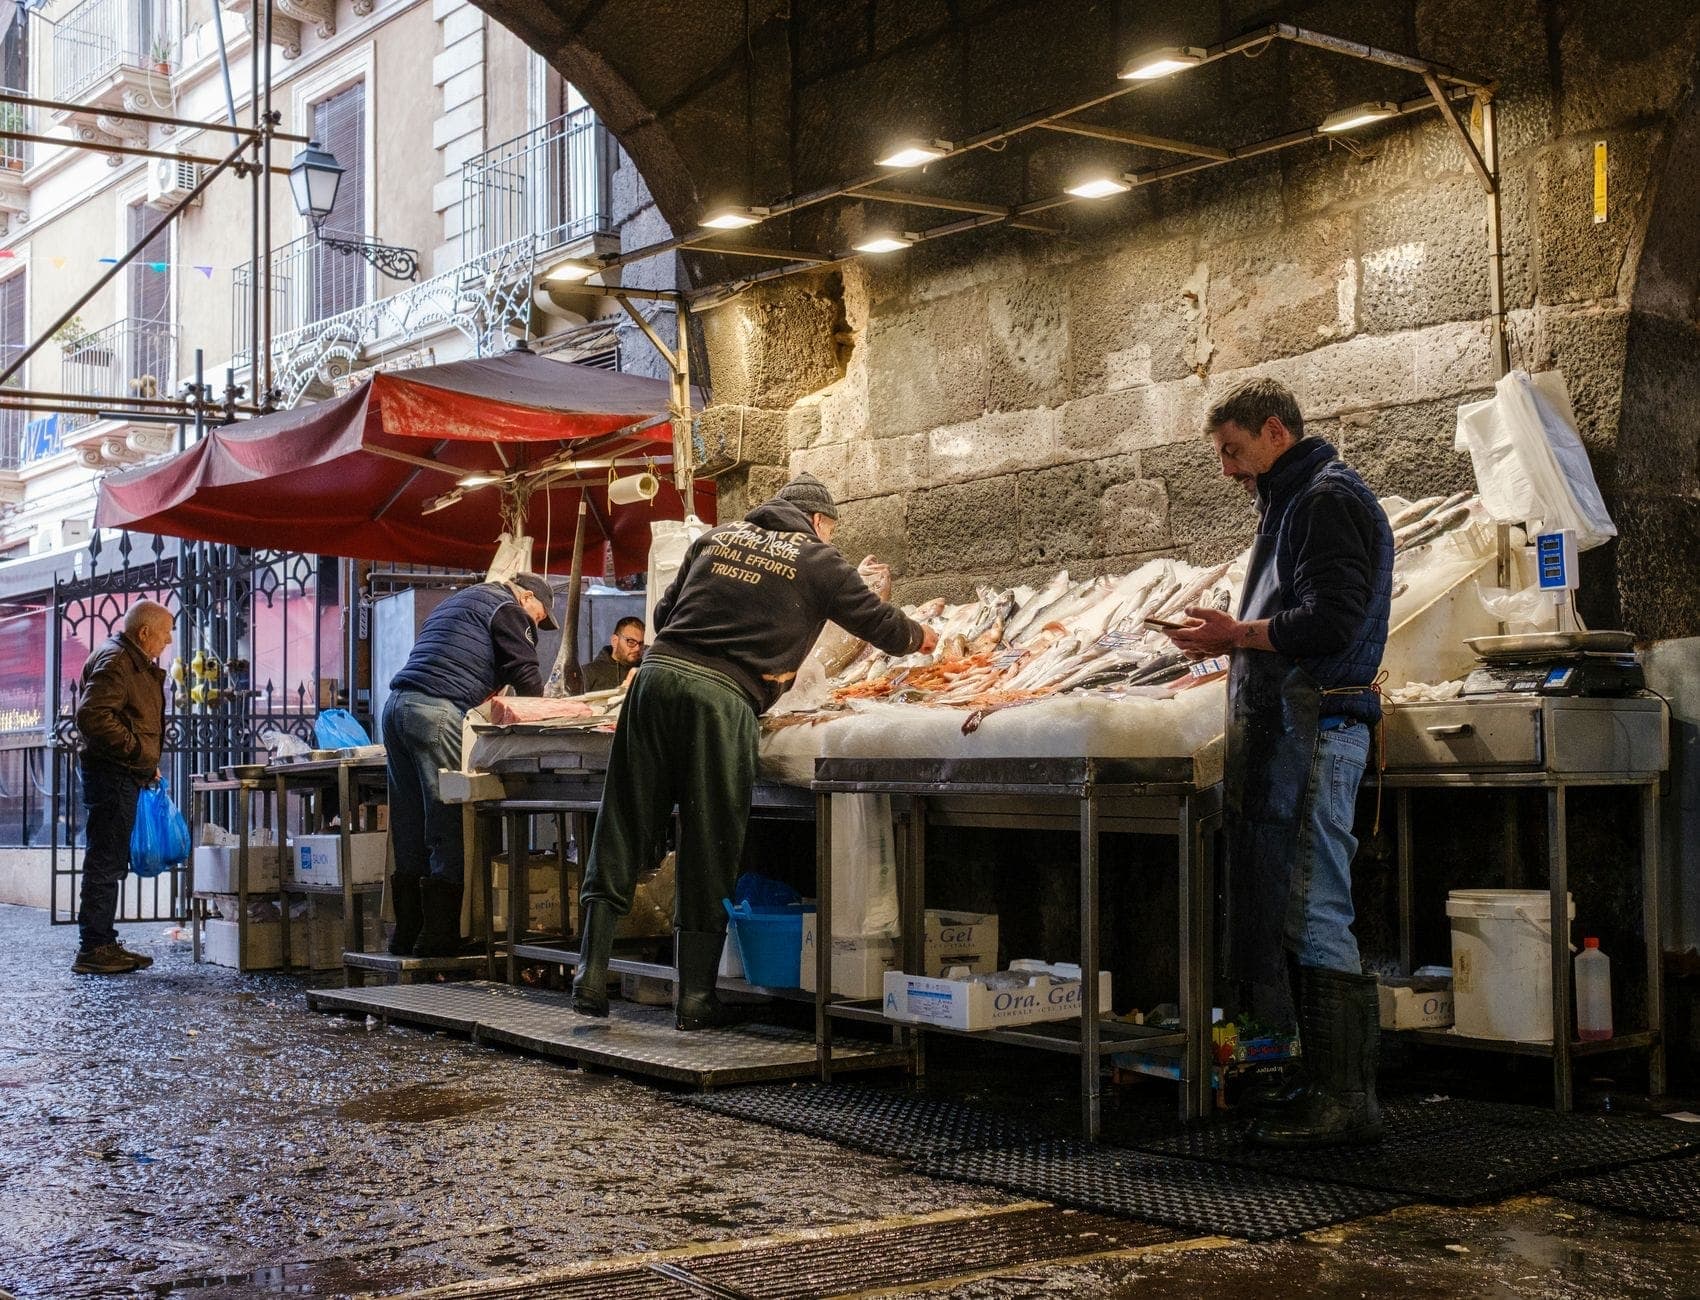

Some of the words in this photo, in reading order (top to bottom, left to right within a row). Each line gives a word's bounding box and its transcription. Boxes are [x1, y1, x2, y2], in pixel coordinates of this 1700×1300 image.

[701, 543, 742, 562] NATURAL
[744, 554, 797, 580] EFFORTS
[710, 562, 762, 585] TRUSTED
[805, 928, 814, 947] A
[940, 927, 973, 943] Gel
[886, 991, 898, 1012] A
[994, 992, 1040, 1011] Ora.
[1048, 985, 1084, 1005] Gel
